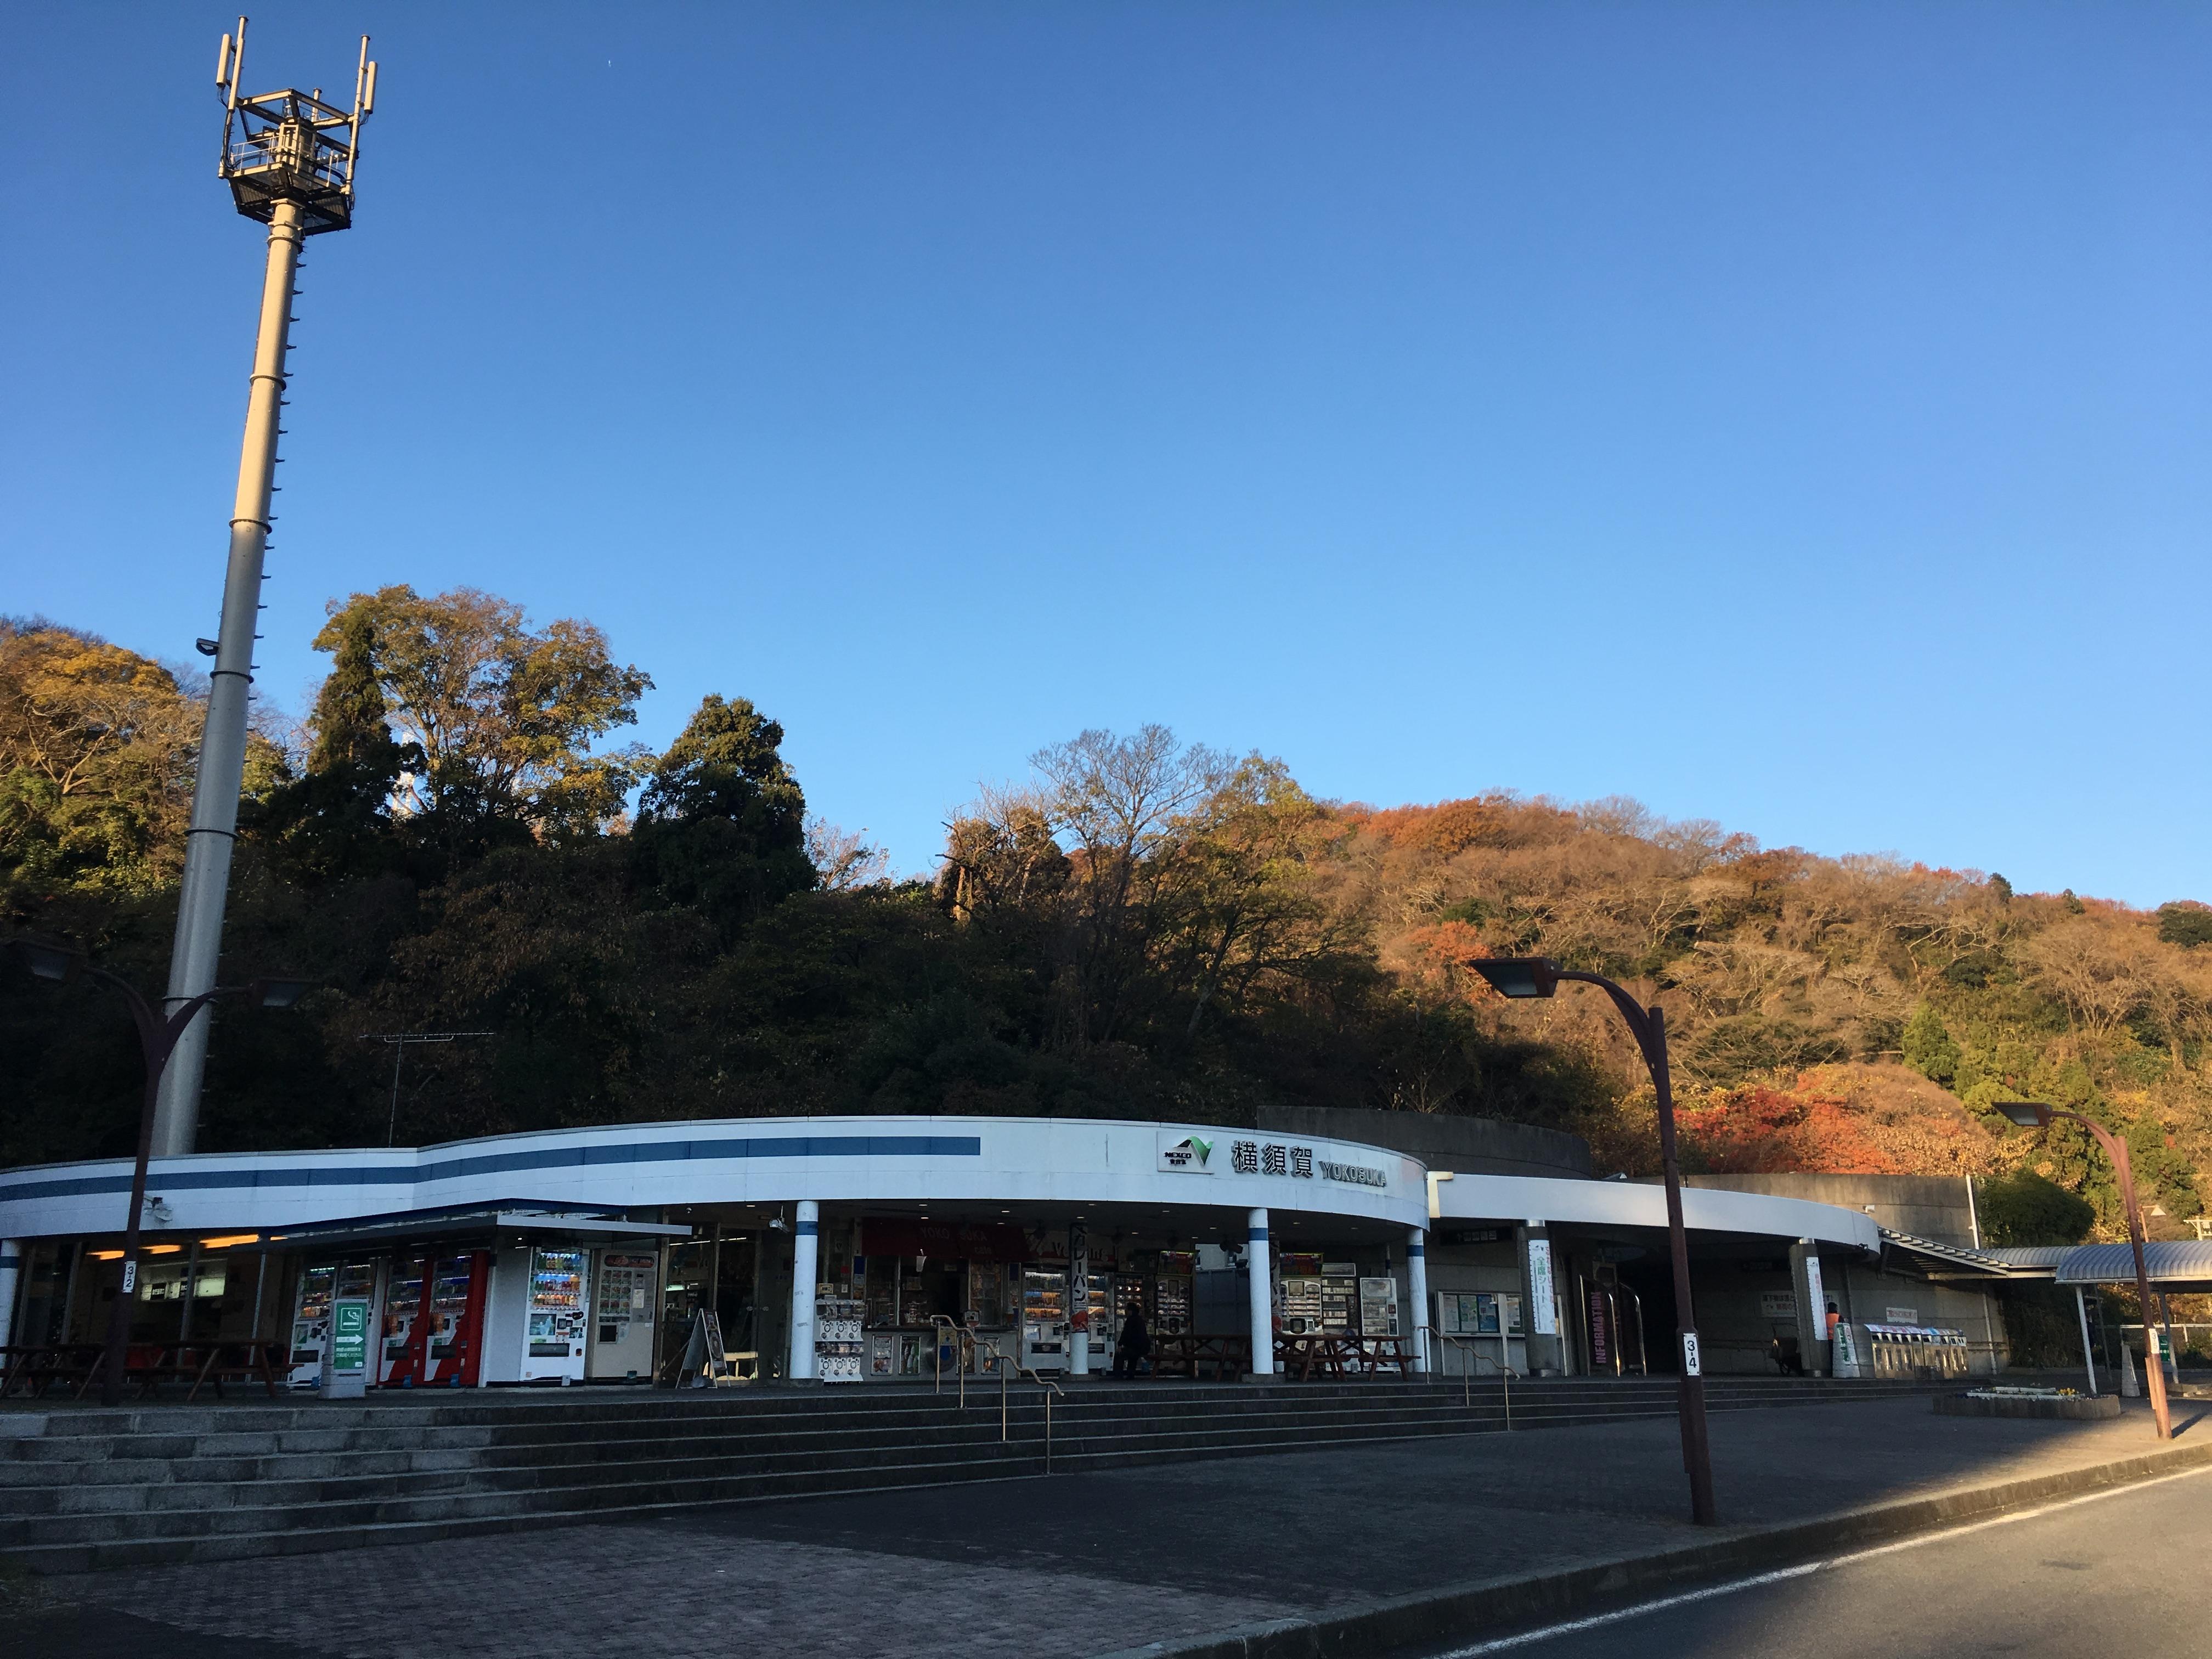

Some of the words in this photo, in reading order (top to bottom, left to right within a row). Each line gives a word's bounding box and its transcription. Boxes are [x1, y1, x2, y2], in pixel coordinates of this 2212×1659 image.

[1232, 1141, 1313, 1178] 横須賀
[1319, 1161, 1387, 1187] YOKOSUKA
[1591, 1291, 1606, 1364] INFORMATION
[1687, 1340, 1697, 1368] 3-4
